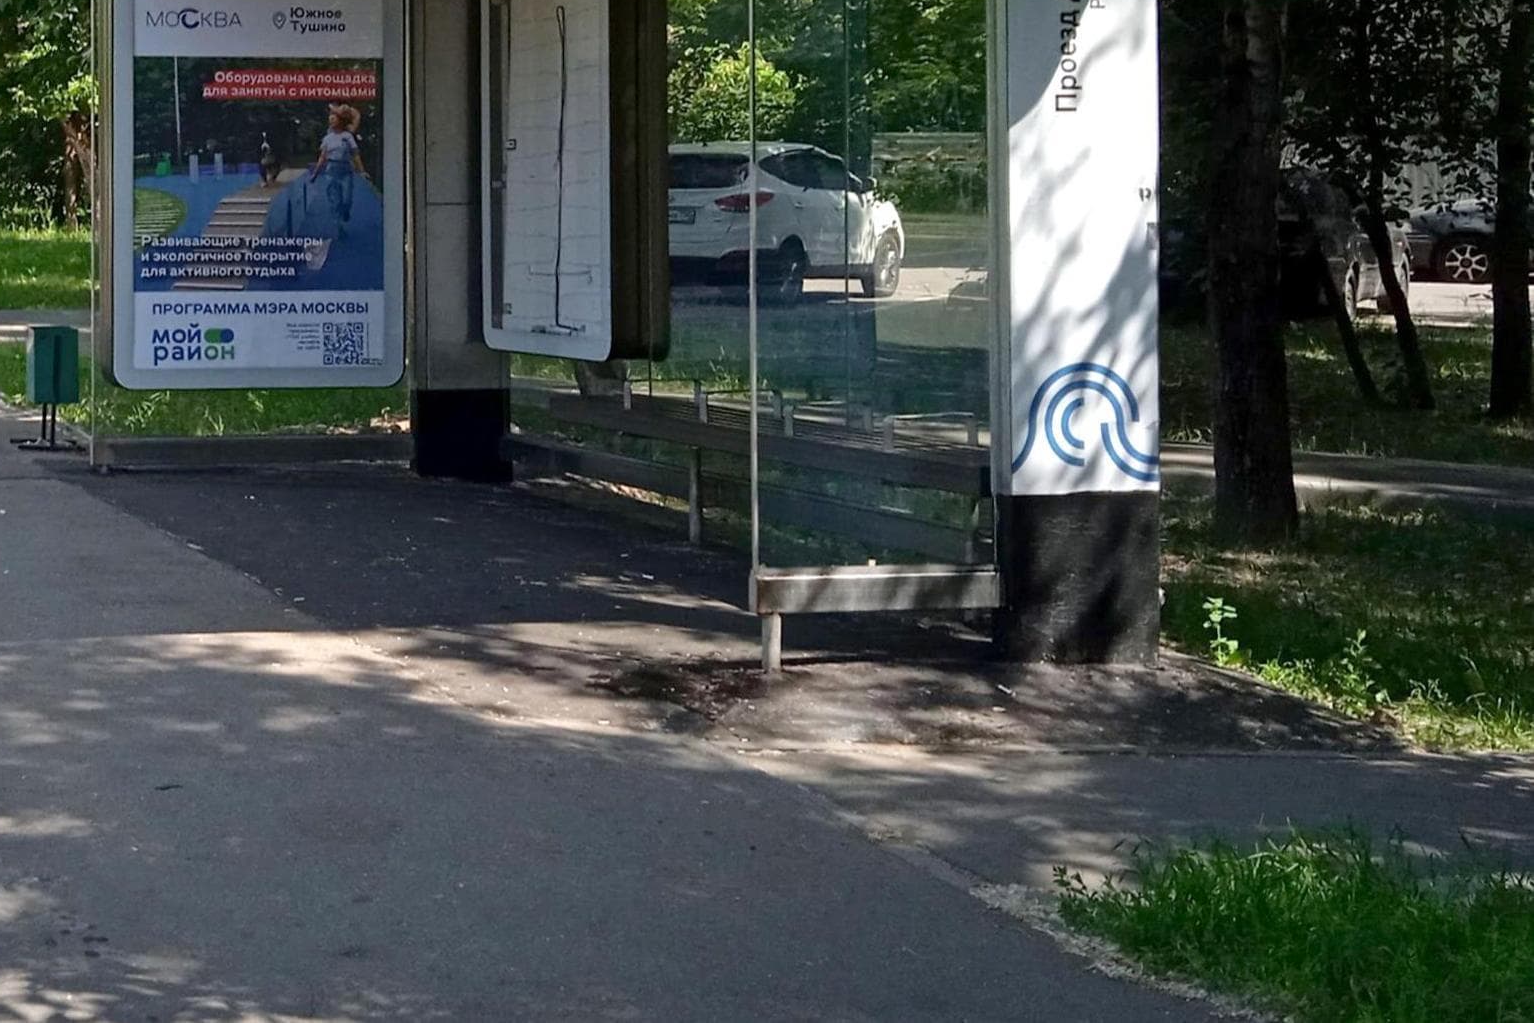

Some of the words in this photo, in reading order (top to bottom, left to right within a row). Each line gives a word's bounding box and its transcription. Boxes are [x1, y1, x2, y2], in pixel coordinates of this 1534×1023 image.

[146, 8, 242, 29] МОСКВА
[290, 7, 342, 19] Южное
[291, 22, 346, 34] Тушино
[1055, 10, 1082, 112] Проезд
[215, 71, 304, 85] Оборудована
[308, 73, 376, 85] площадка
[203, 87, 227, 98] для
[231, 85, 286, 96] занятий
[288, 87, 297, 97] с
[300, 87, 377, 98] питомцами
[141, 234, 240, 248] Развивающие
[243, 237, 323, 249] тренажеры
[141, 252, 150, 262] и
[153, 252, 242, 262] экологичное
[245, 252, 313, 264] покрытие
[140, 267, 167, 278] для
[170, 267, 242, 277] активного
[245, 267, 296, 278] отдыха
[152, 303, 250, 315] ПРОГРАММА
[254, 303, 297, 315] МЭРА
[301, 302, 368, 315] МОСКВЫ
[152, 323, 201, 344] мой
